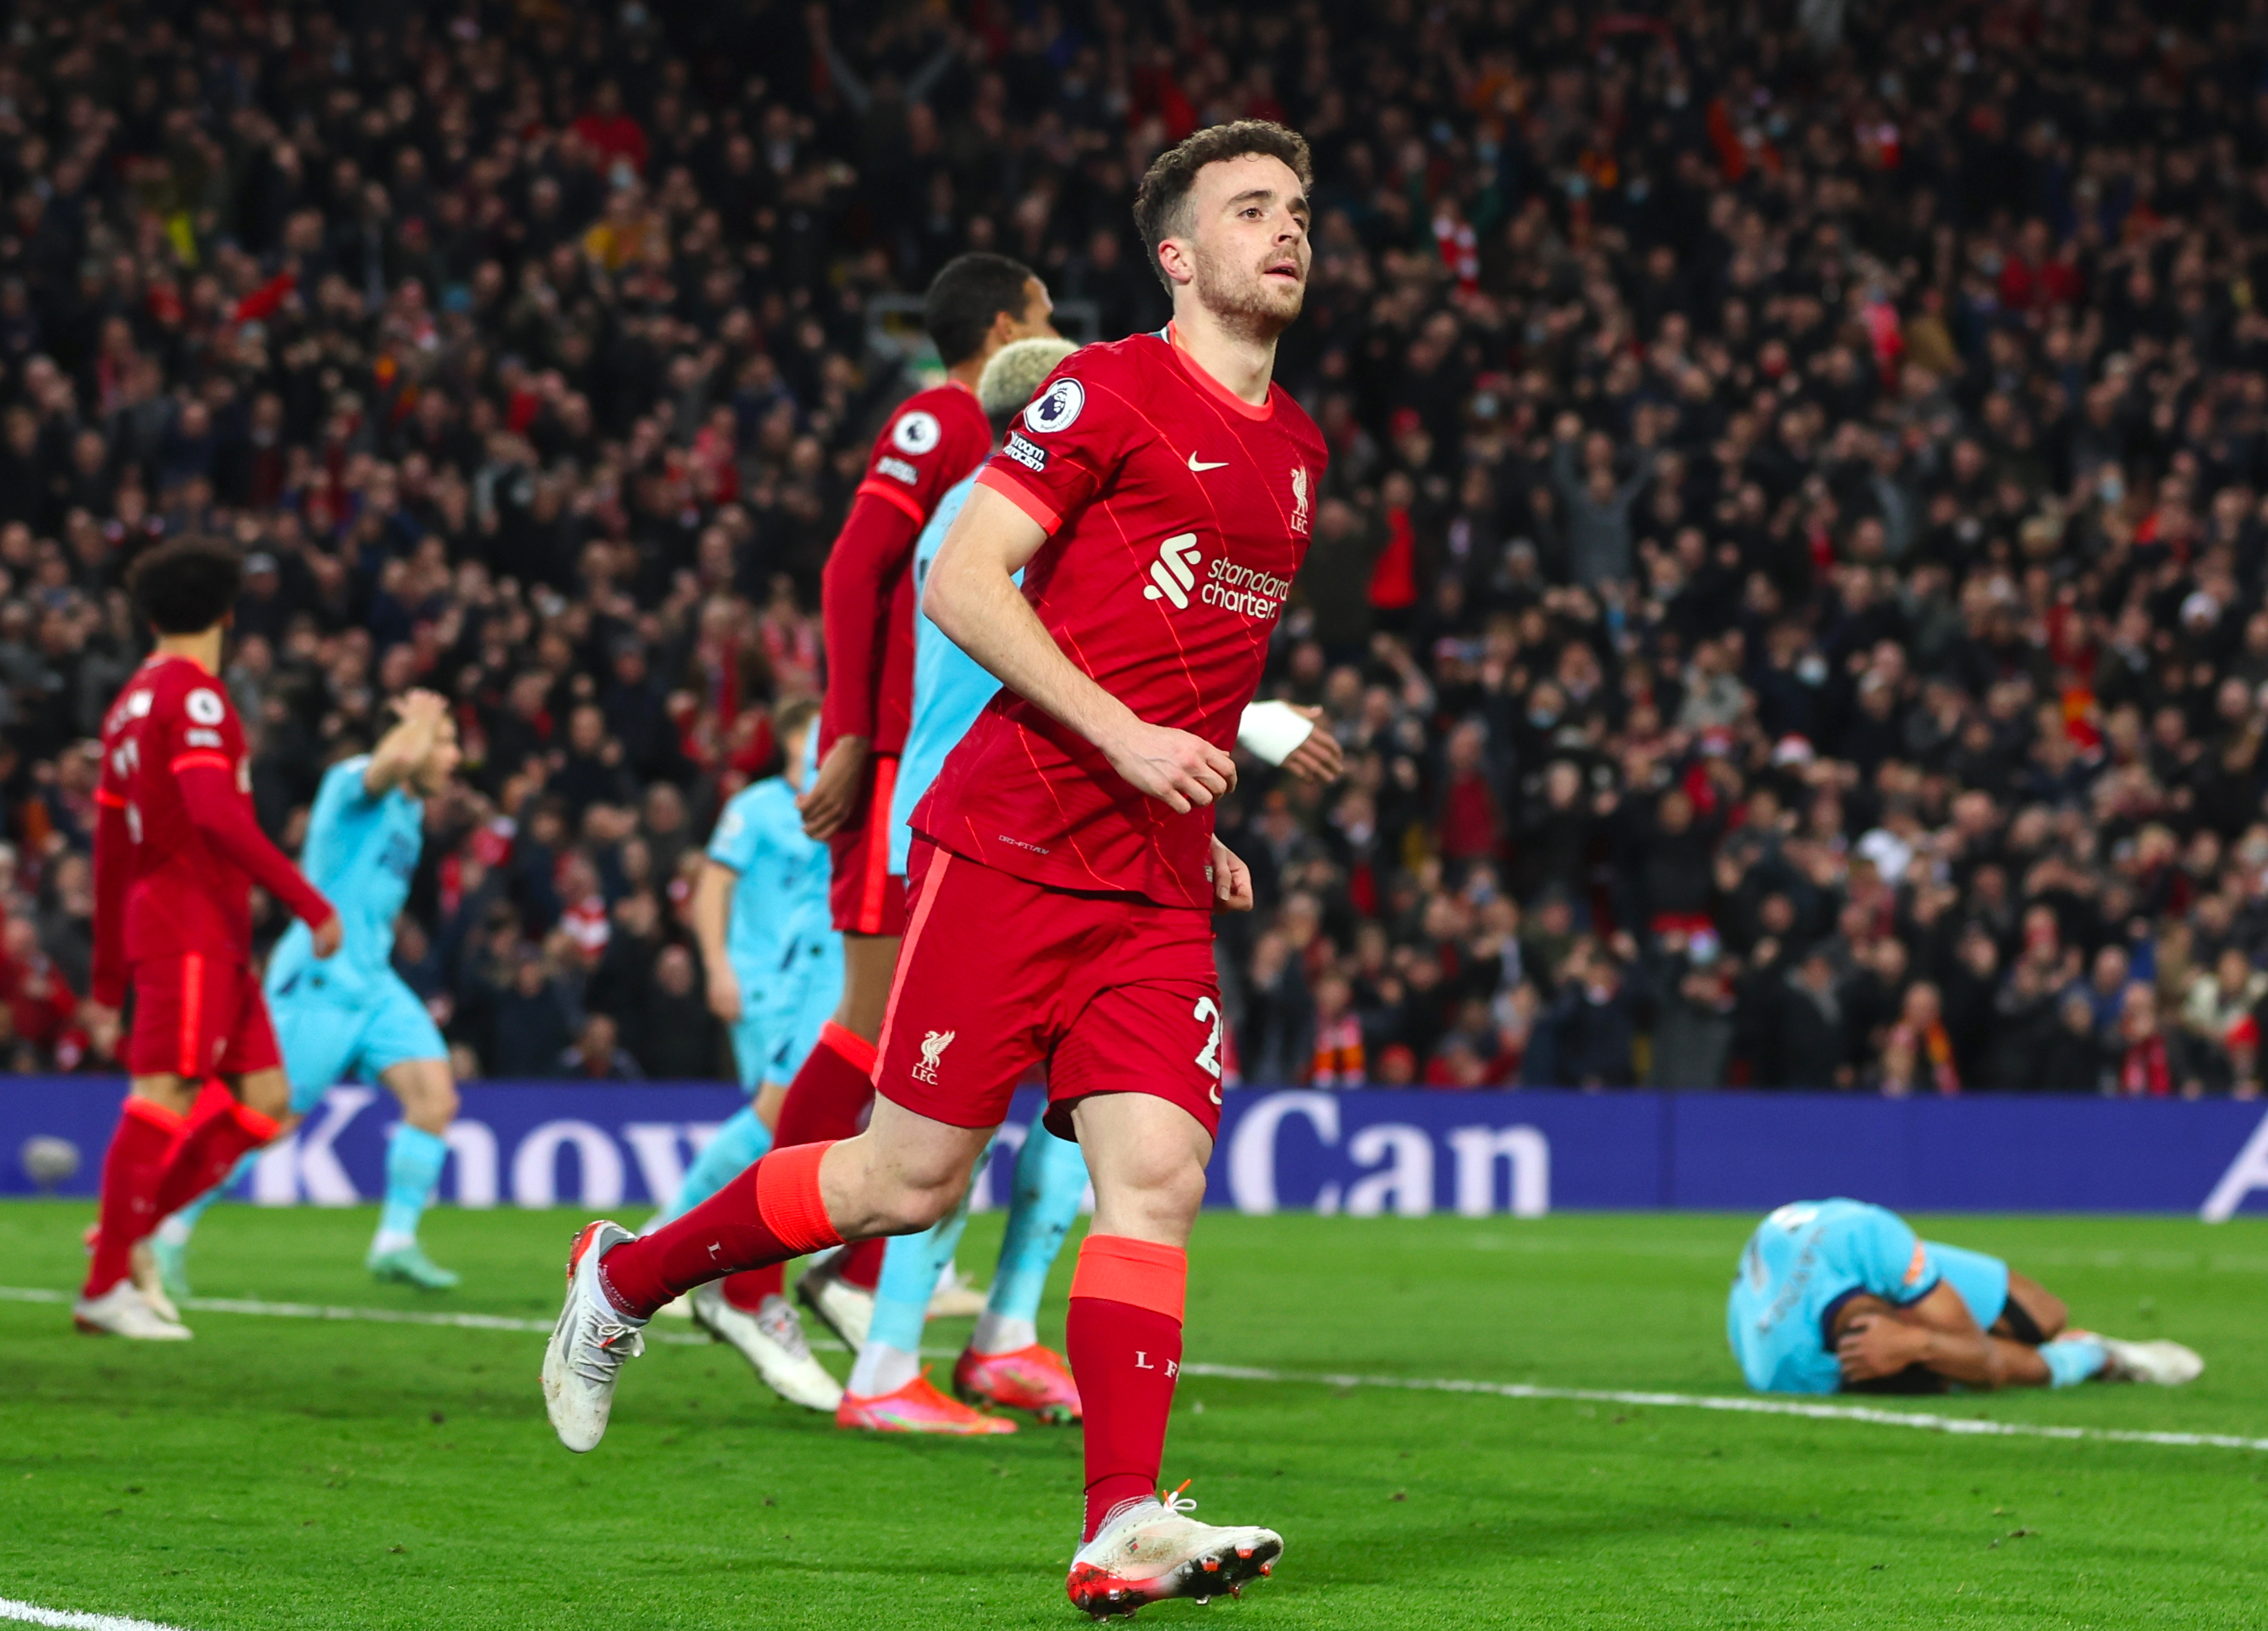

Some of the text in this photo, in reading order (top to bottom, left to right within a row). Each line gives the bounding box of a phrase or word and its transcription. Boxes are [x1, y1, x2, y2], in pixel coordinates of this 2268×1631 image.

[1008, 448, 1044, 472] racism
[1015, 437, 1044, 461] room
[1291, 514, 1308, 535] LFC
[1202, 581, 1277, 620] charter
[1193, 996, 1224, 1080] 2
[911, 1066, 938, 1086] LFC
[1227, 1090, 1551, 1218] Can
[1135, 1350, 1180, 1383] LF
